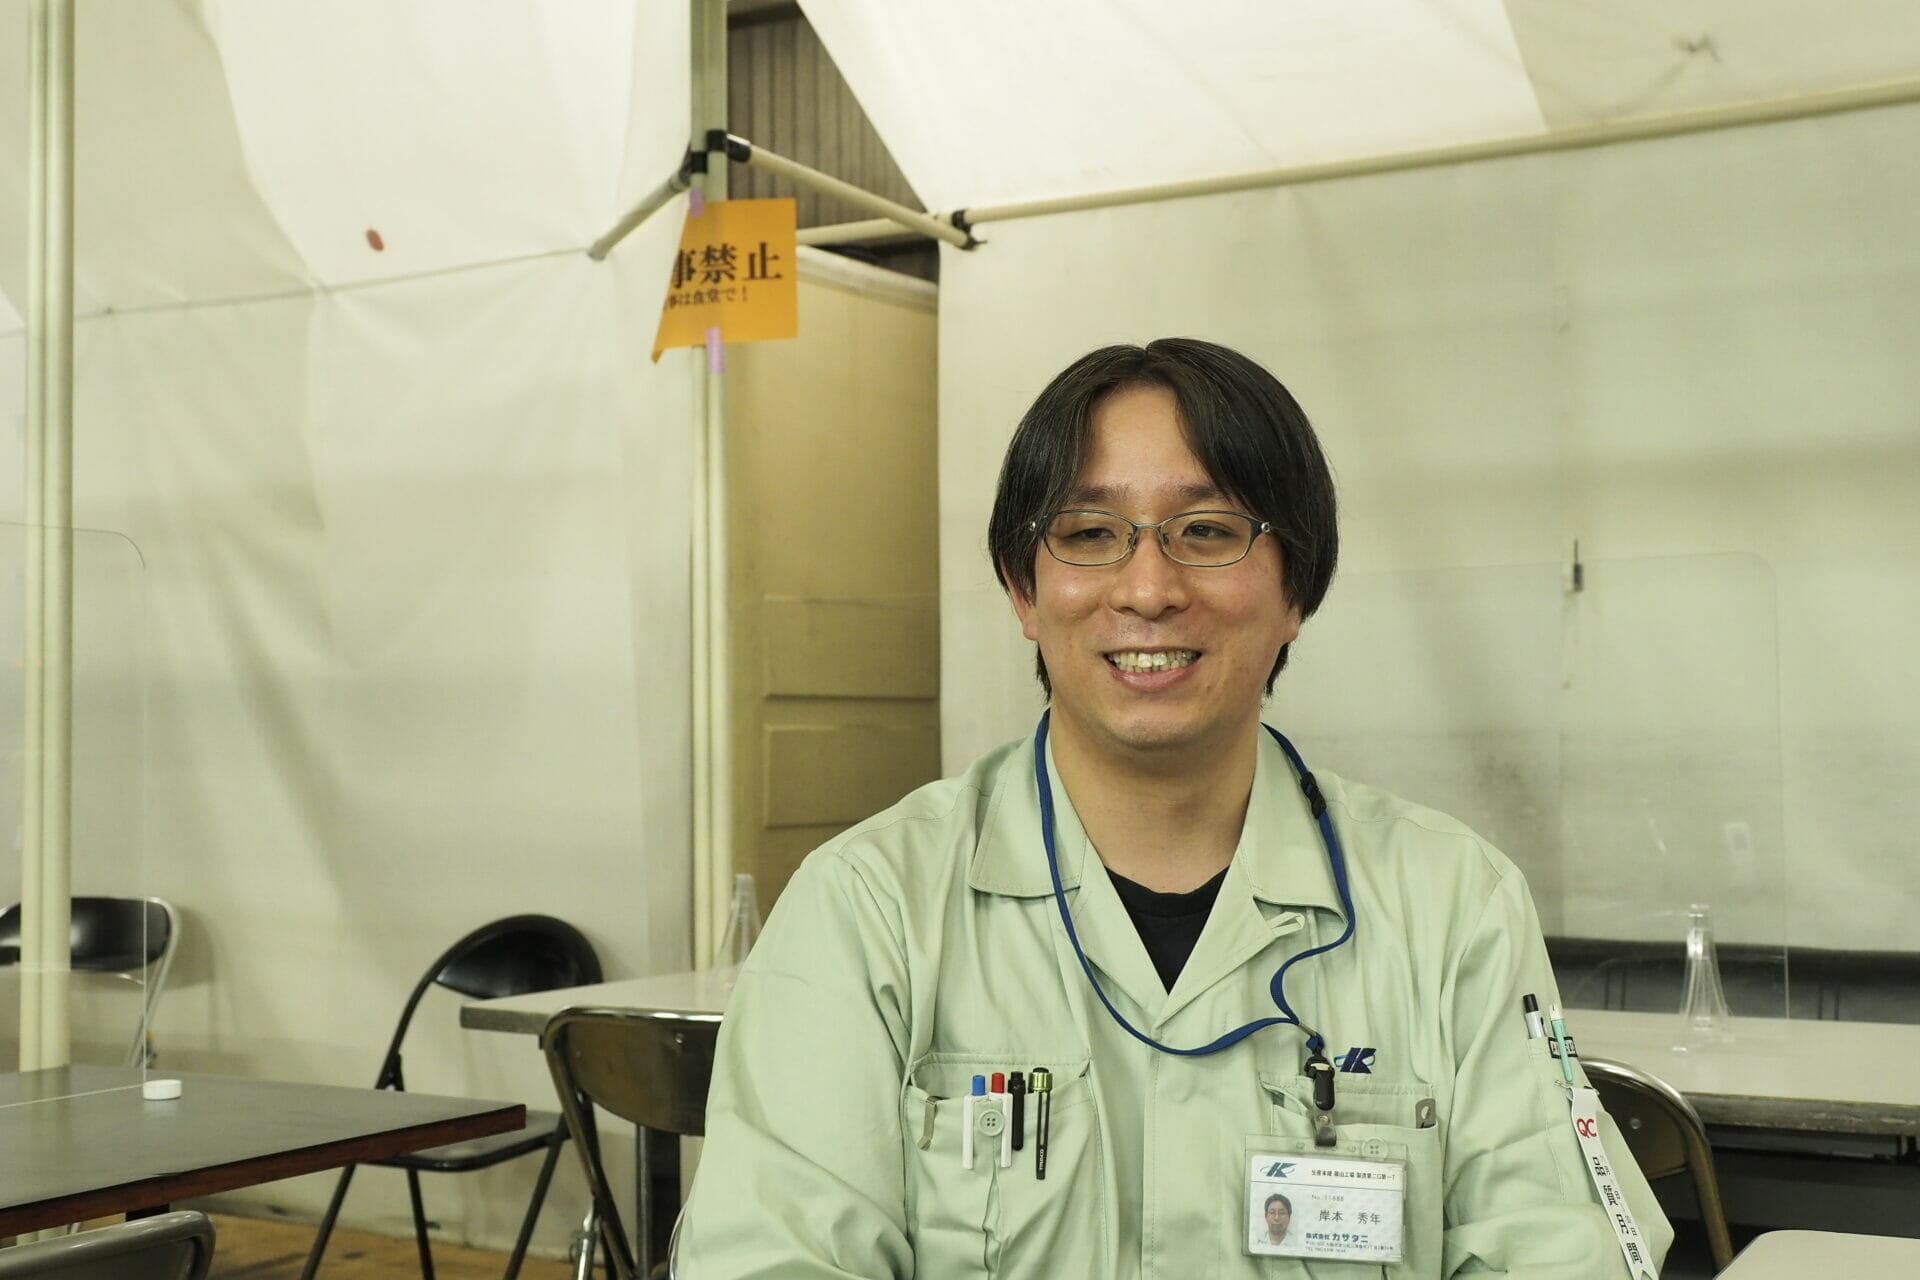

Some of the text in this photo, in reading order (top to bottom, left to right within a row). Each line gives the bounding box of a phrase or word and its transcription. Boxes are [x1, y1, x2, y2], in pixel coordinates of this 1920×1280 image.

[1576, 1118, 1597, 1139] QC
[1318, 1209, 1382, 1225] 岸本 秀年
[1592, 1156, 1643, 1265] 品質月間
[1331, 1232, 1369, 1243] カサタニ
